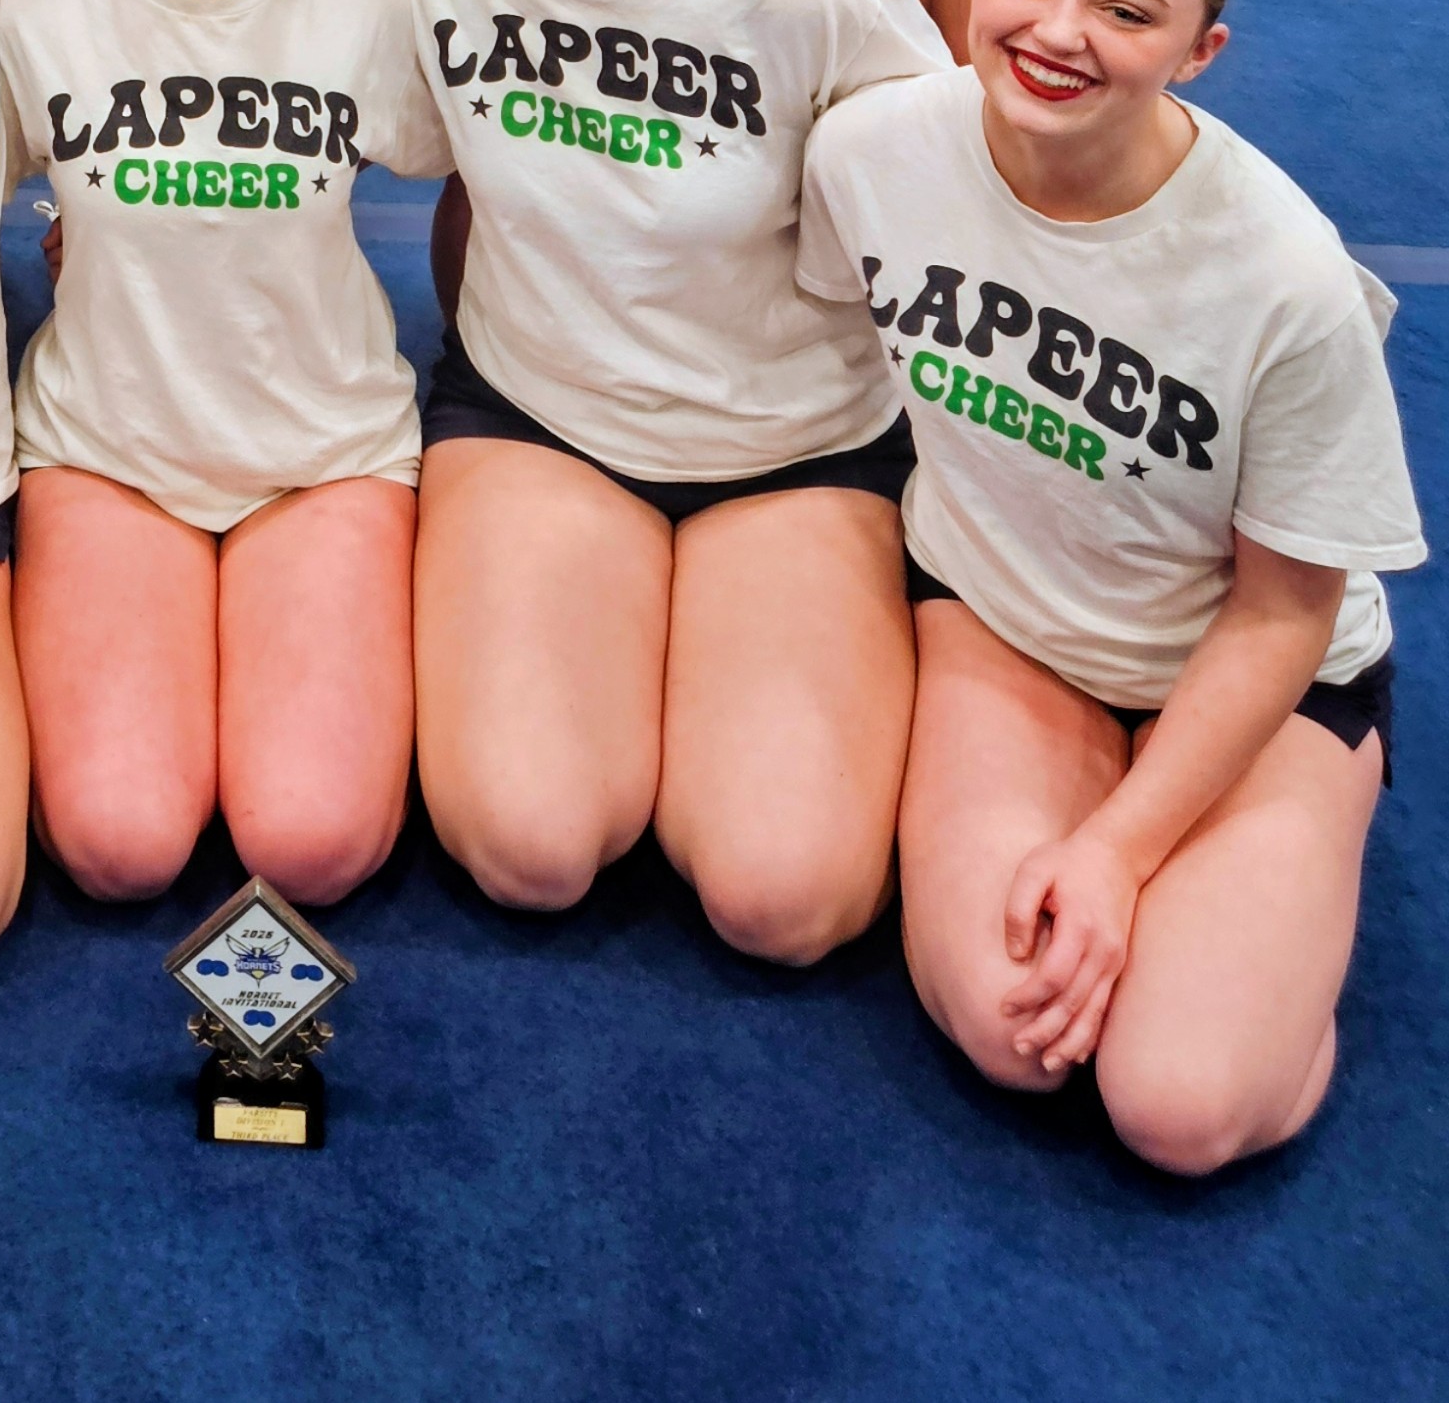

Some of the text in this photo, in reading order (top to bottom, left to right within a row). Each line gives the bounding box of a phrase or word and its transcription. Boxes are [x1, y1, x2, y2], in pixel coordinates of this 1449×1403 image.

[434, 14, 767, 137] LAPEER
[48, 76, 361, 167] LAPEER
[501, 91, 683, 169] CHEER
[114, 158, 300, 210] CHEER
[862, 255, 1220, 471] LAPEER
[909, 350, 1105, 481] CHEER
[236, 959, 280, 972] HORNETS
